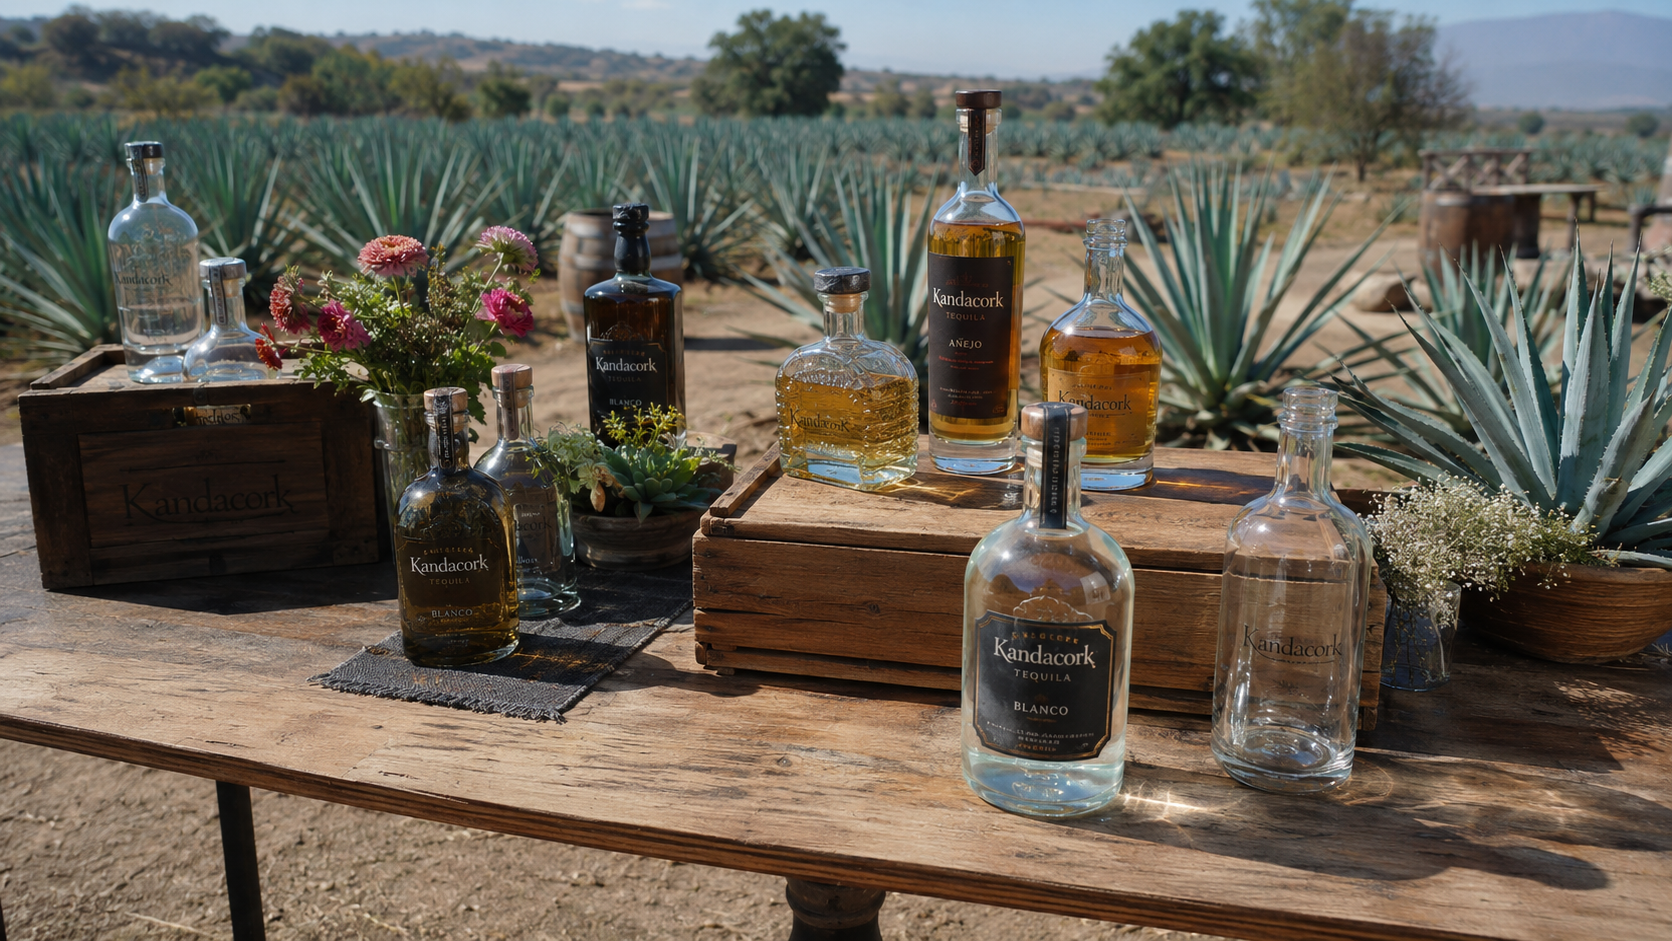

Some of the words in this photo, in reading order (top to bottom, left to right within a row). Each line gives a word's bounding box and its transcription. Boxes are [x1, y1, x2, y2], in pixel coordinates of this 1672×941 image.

[932, 287, 1005, 309] Kandacork
[945, 311, 986, 321] TEQUILA
[948, 337, 983, 349] AÑEJO
[595, 356, 658, 373] Kandacork
[118, 473, 300, 521] Kandacork
[410, 553, 489, 576] Kandacork
[431, 608, 473, 618] BLANCO
[1243, 625, 1342, 660] Kandacork
[993, 636, 1096, 668] Kandacork
[1014, 668, 1072, 683] TEQUILA
[1014, 701, 1069, 716] BLANCO
